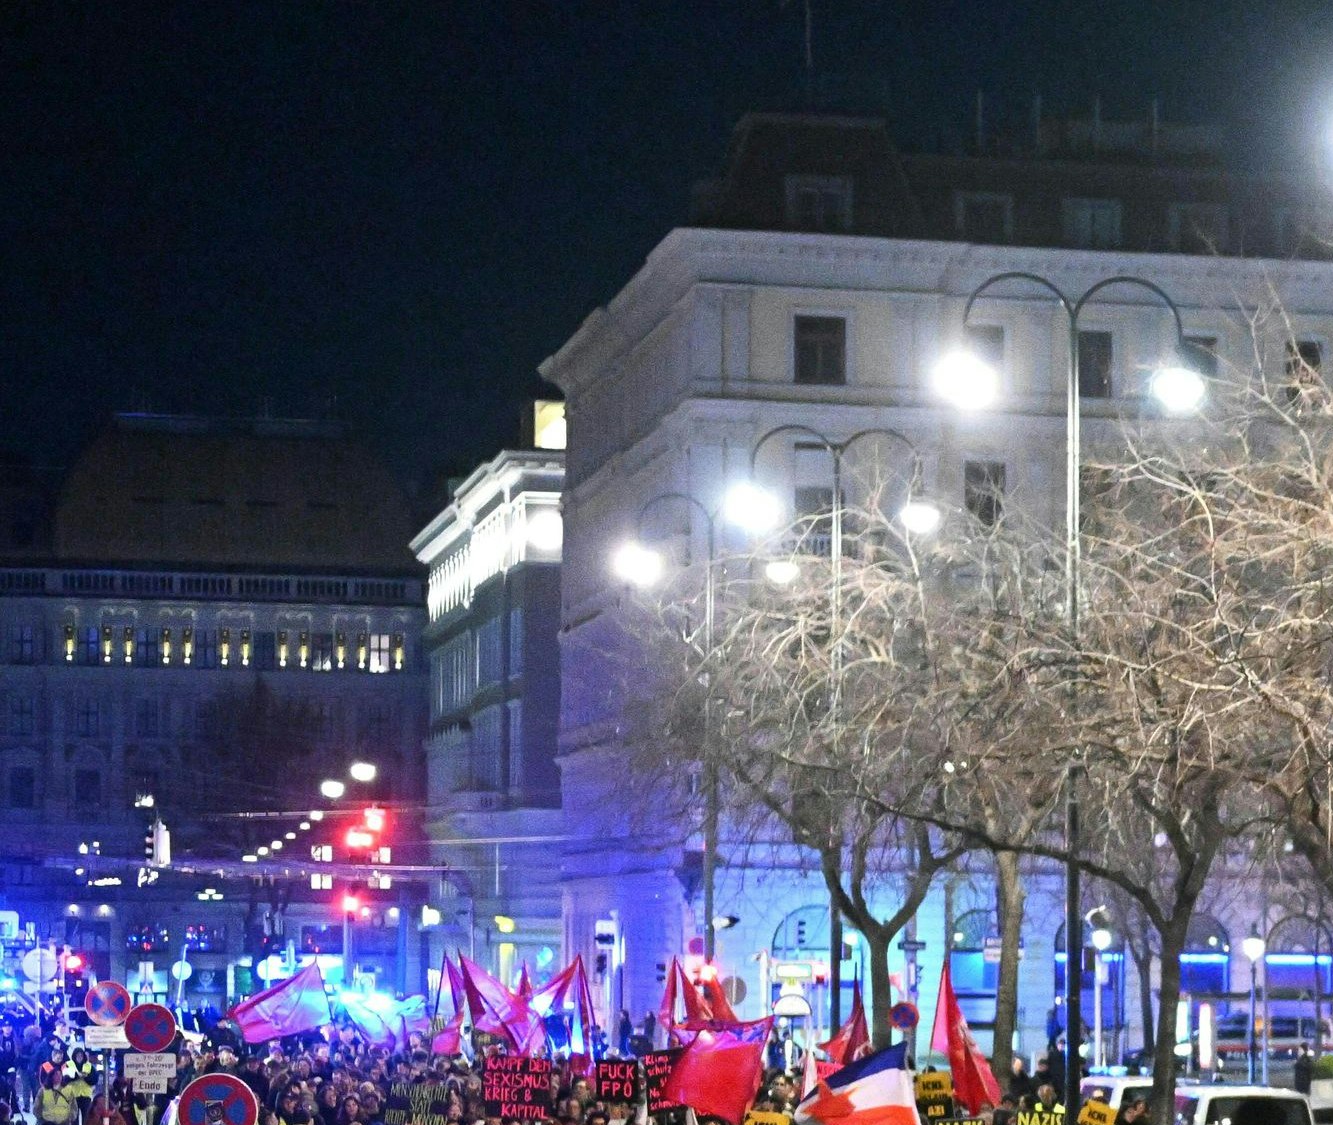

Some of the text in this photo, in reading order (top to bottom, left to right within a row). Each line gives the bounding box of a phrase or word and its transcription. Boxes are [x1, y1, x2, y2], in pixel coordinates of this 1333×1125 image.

[486, 1056, 551, 1072] KAMPF DEM
[599, 1063, 636, 1080] FUCK
[484, 1073, 551, 1090] SEXISMUS
[485, 1087, 533, 1101] KRIEG &
[501, 1103, 549, 1119] KAPITAL
